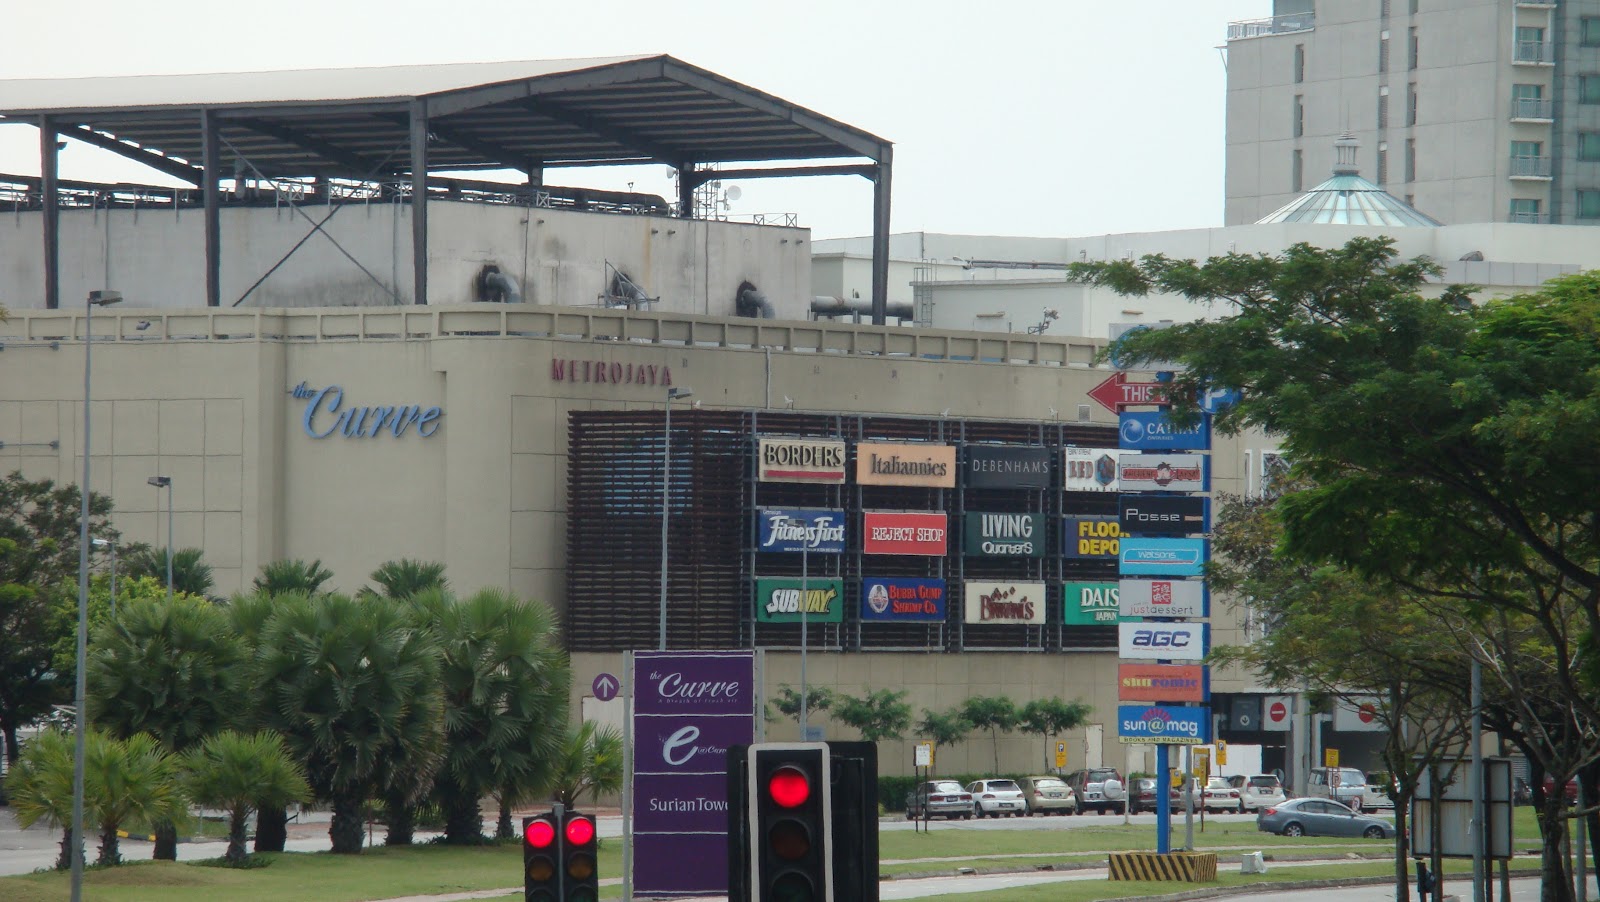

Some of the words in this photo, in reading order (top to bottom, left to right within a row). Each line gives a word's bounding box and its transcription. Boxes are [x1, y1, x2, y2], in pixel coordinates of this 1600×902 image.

[552, 359, 672, 386] METROJAYA
[291, 381, 314, 399] the
[303, 386, 442, 439] Curve
[765, 444, 844, 467] BORDERS
[871, 453, 947, 476] Italiannies
[973, 459, 1049, 473] DEBENHAMS
[1126, 508, 1180, 521] Posse
[809, 516, 845, 548] First
[871, 527, 914, 542] REJECT
[916, 528, 944, 542] SHOP
[982, 514, 1033, 539] LIVING
[1078, 521, 1130, 538] FLOO
[1138, 550, 1176, 559] watsons
[1095, 612, 1117, 620] JAPAN
[650, 671, 661, 680] the
[658, 672, 739, 697] Curve
